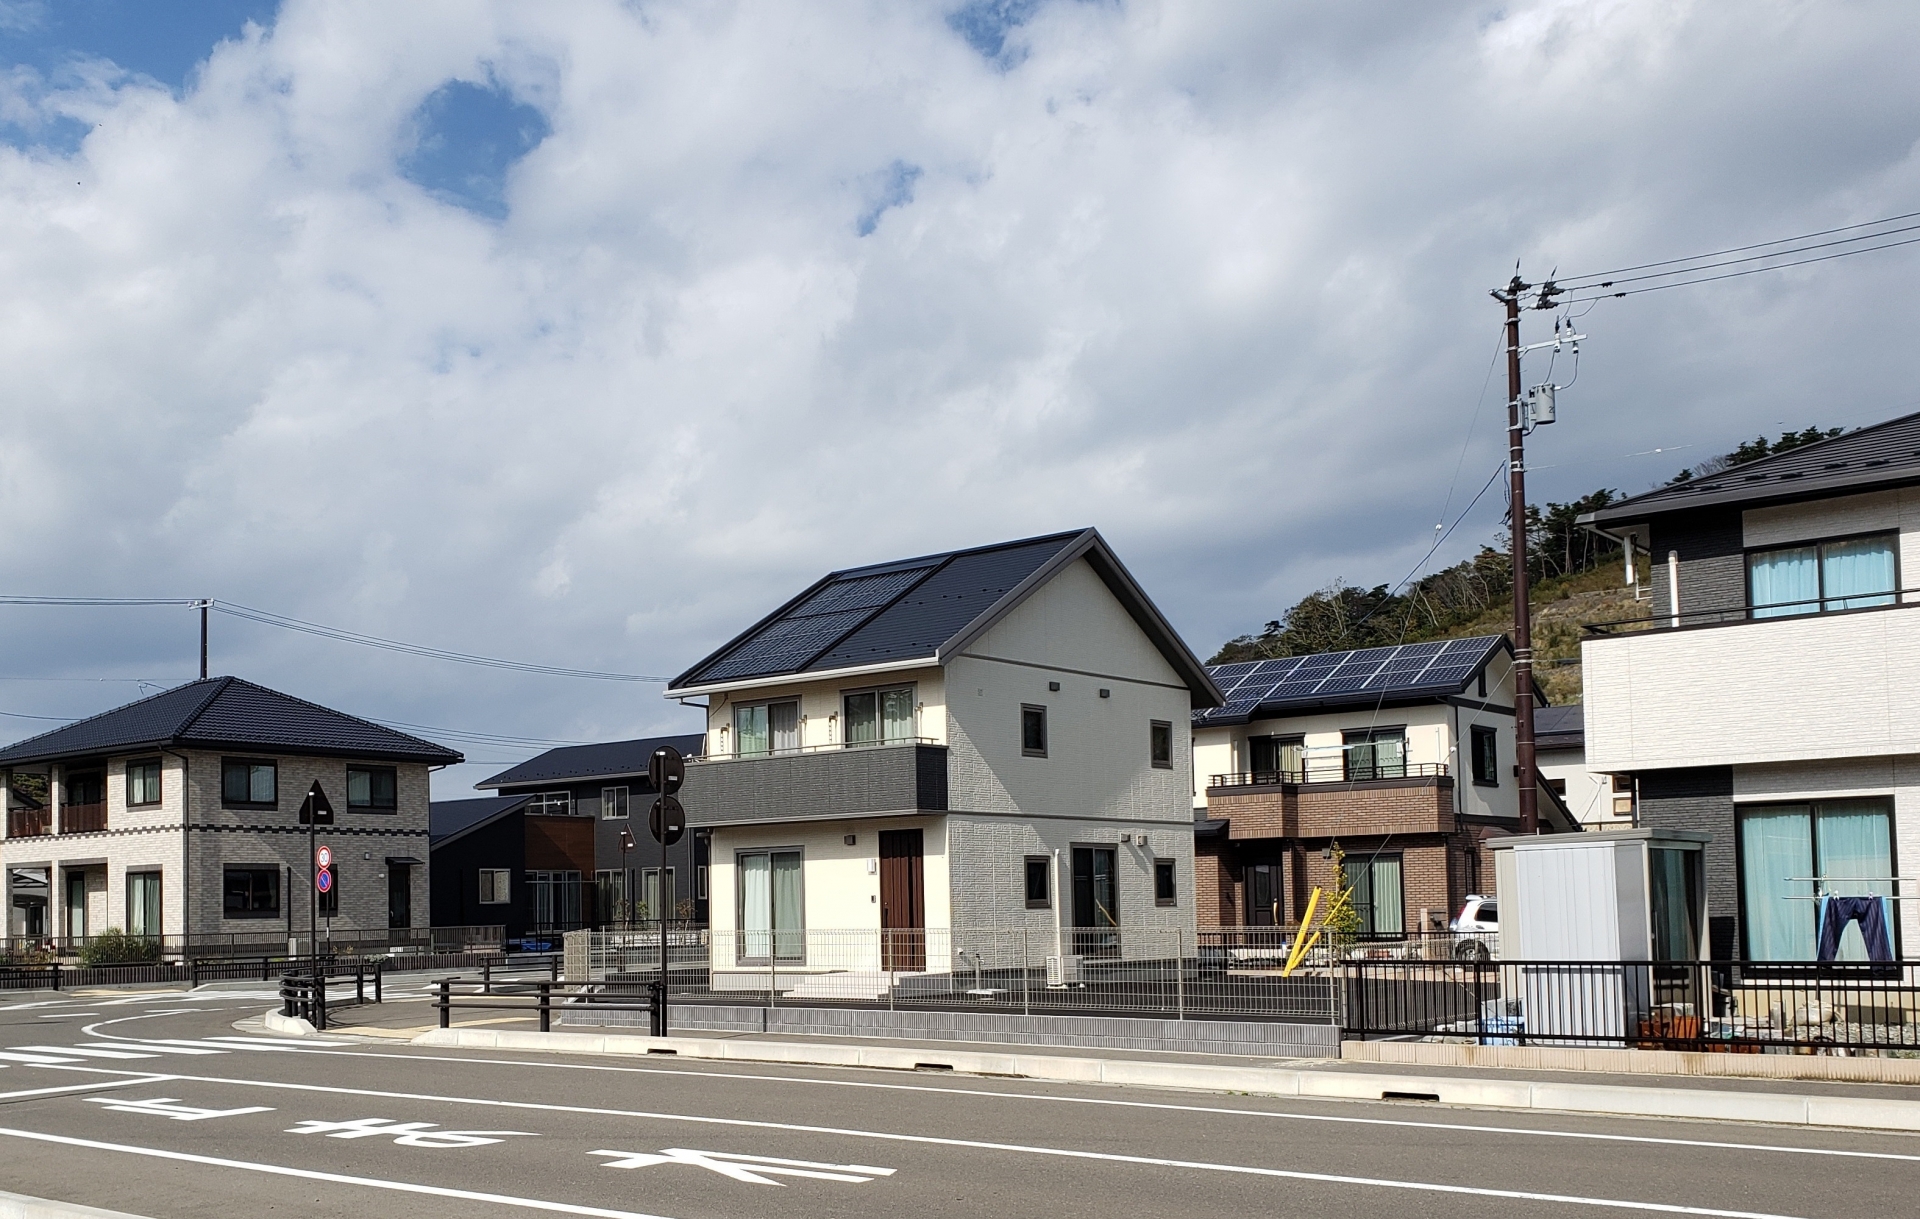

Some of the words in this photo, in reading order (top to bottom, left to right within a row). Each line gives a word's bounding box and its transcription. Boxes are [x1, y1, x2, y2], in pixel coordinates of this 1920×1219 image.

[320, 852, 328, 863] 30
[82, 1097, 898, 1187] 止まれ
